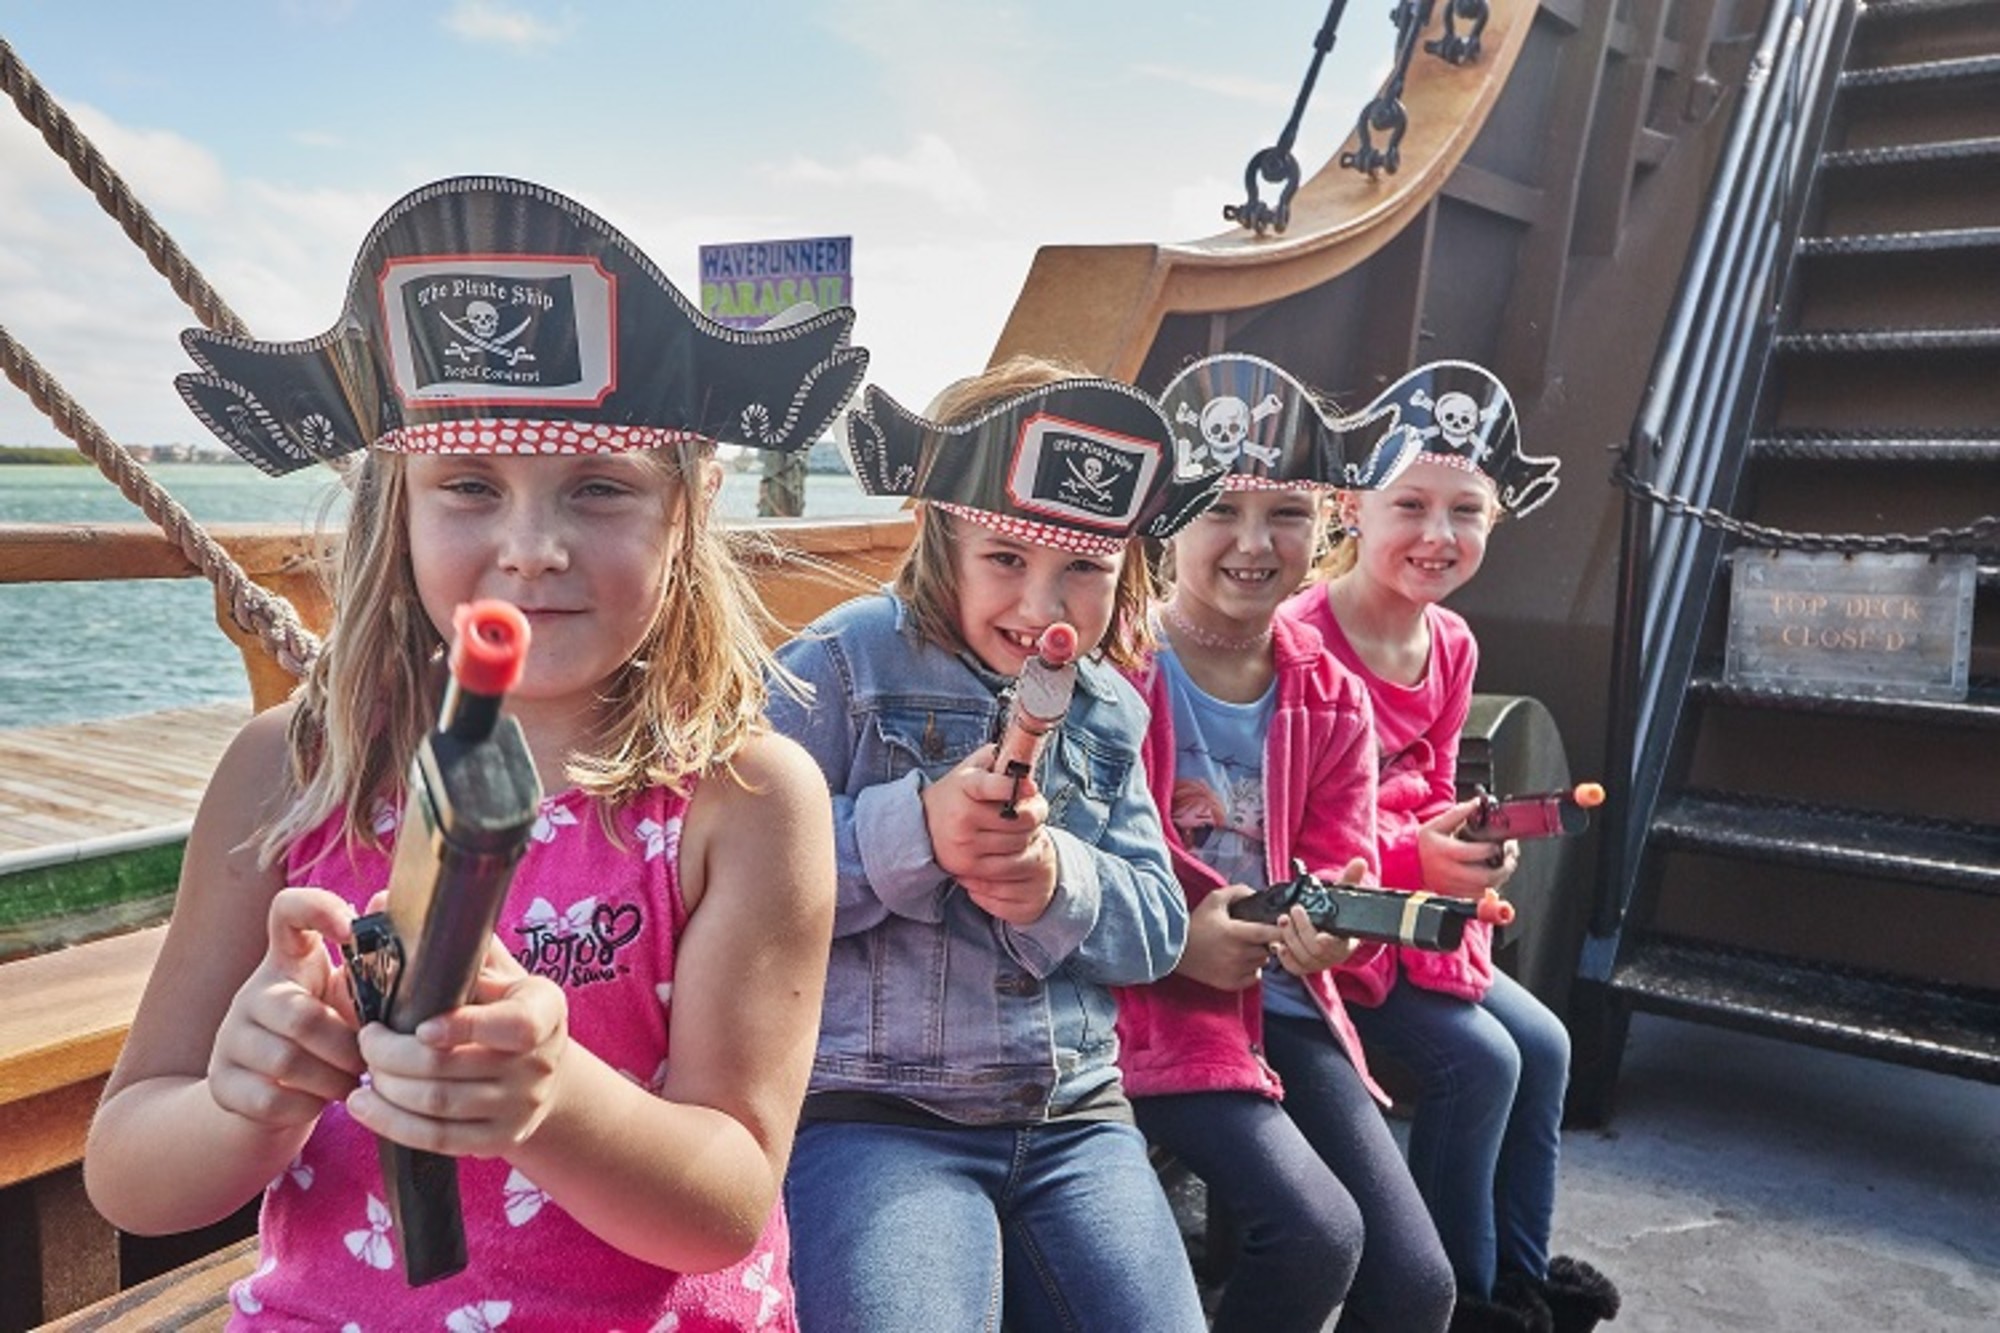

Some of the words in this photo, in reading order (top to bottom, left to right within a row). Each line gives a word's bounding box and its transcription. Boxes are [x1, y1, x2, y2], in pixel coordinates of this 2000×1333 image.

[452, 279, 507, 300] Pirate
[511, 284, 554, 311] Ship
[1770, 594, 1828, 616] TOP
[1845, 597, 1921, 620] DECK
